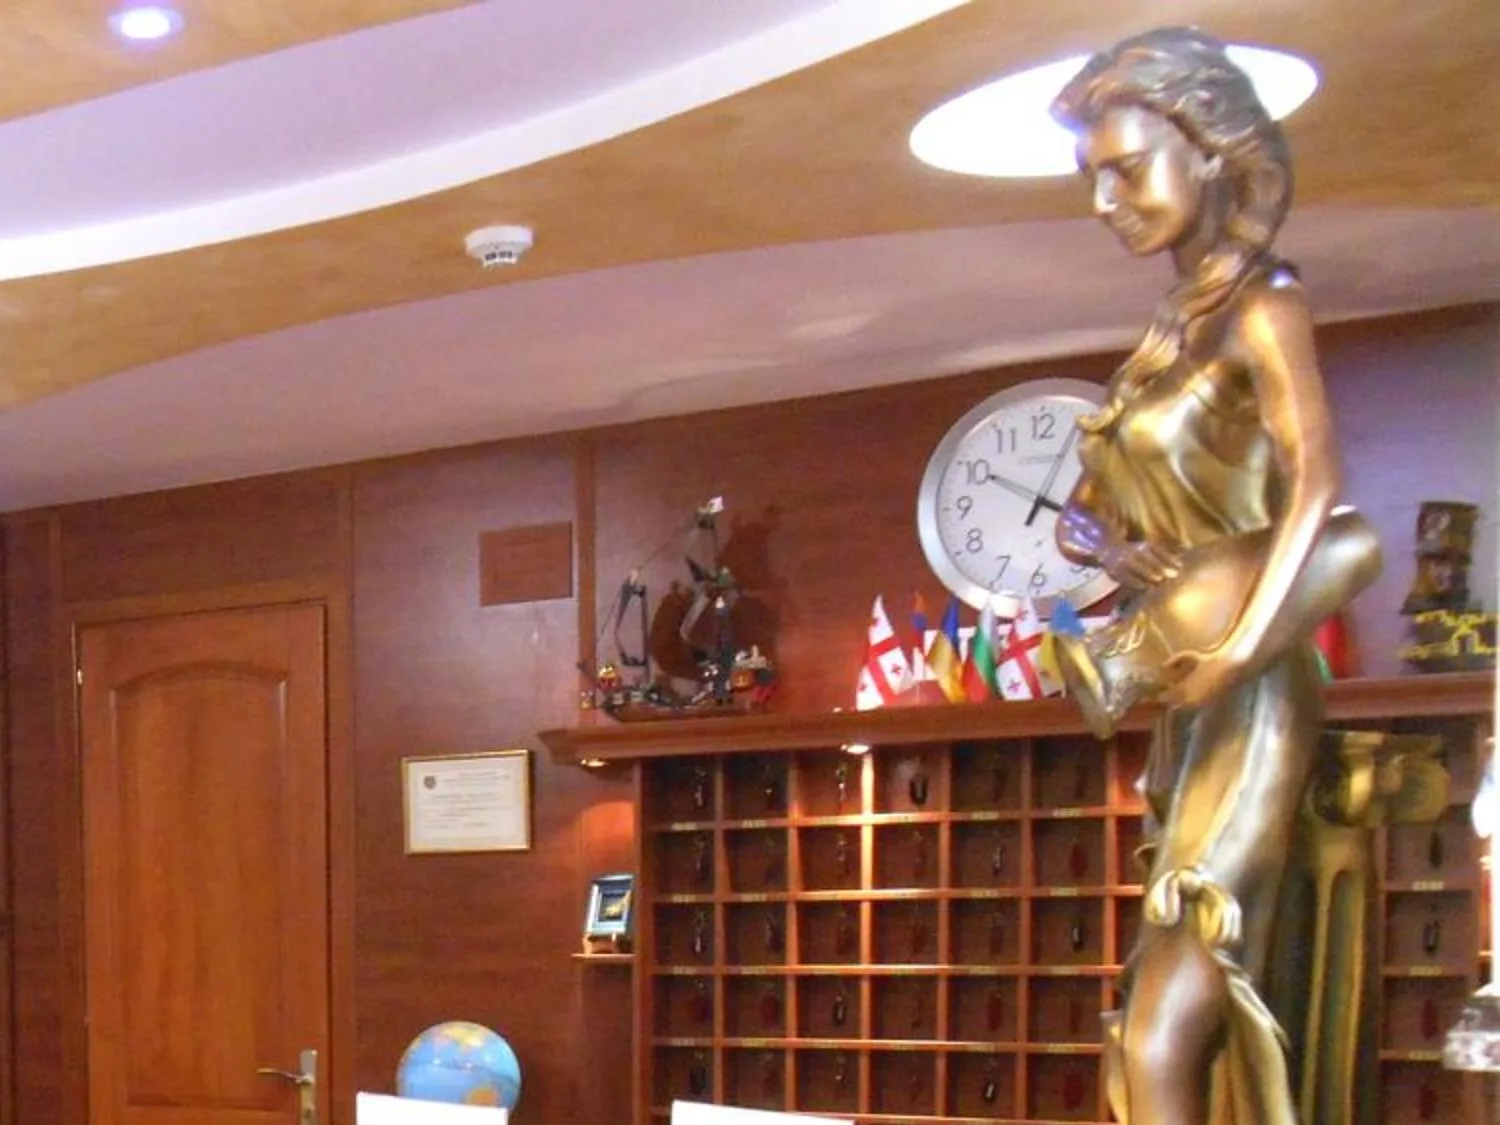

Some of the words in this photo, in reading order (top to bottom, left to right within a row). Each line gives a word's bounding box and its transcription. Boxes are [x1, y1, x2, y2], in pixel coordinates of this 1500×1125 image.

[1031, 412, 1056, 441] 12
[996, 428, 1017, 453] 11
[966, 459, 990, 485] 10
[957, 495, 973, 520] 9
[966, 527, 983, 553] 8
[997, 555, 1011, 578] 7
[1030, 563, 1047, 588] 6
